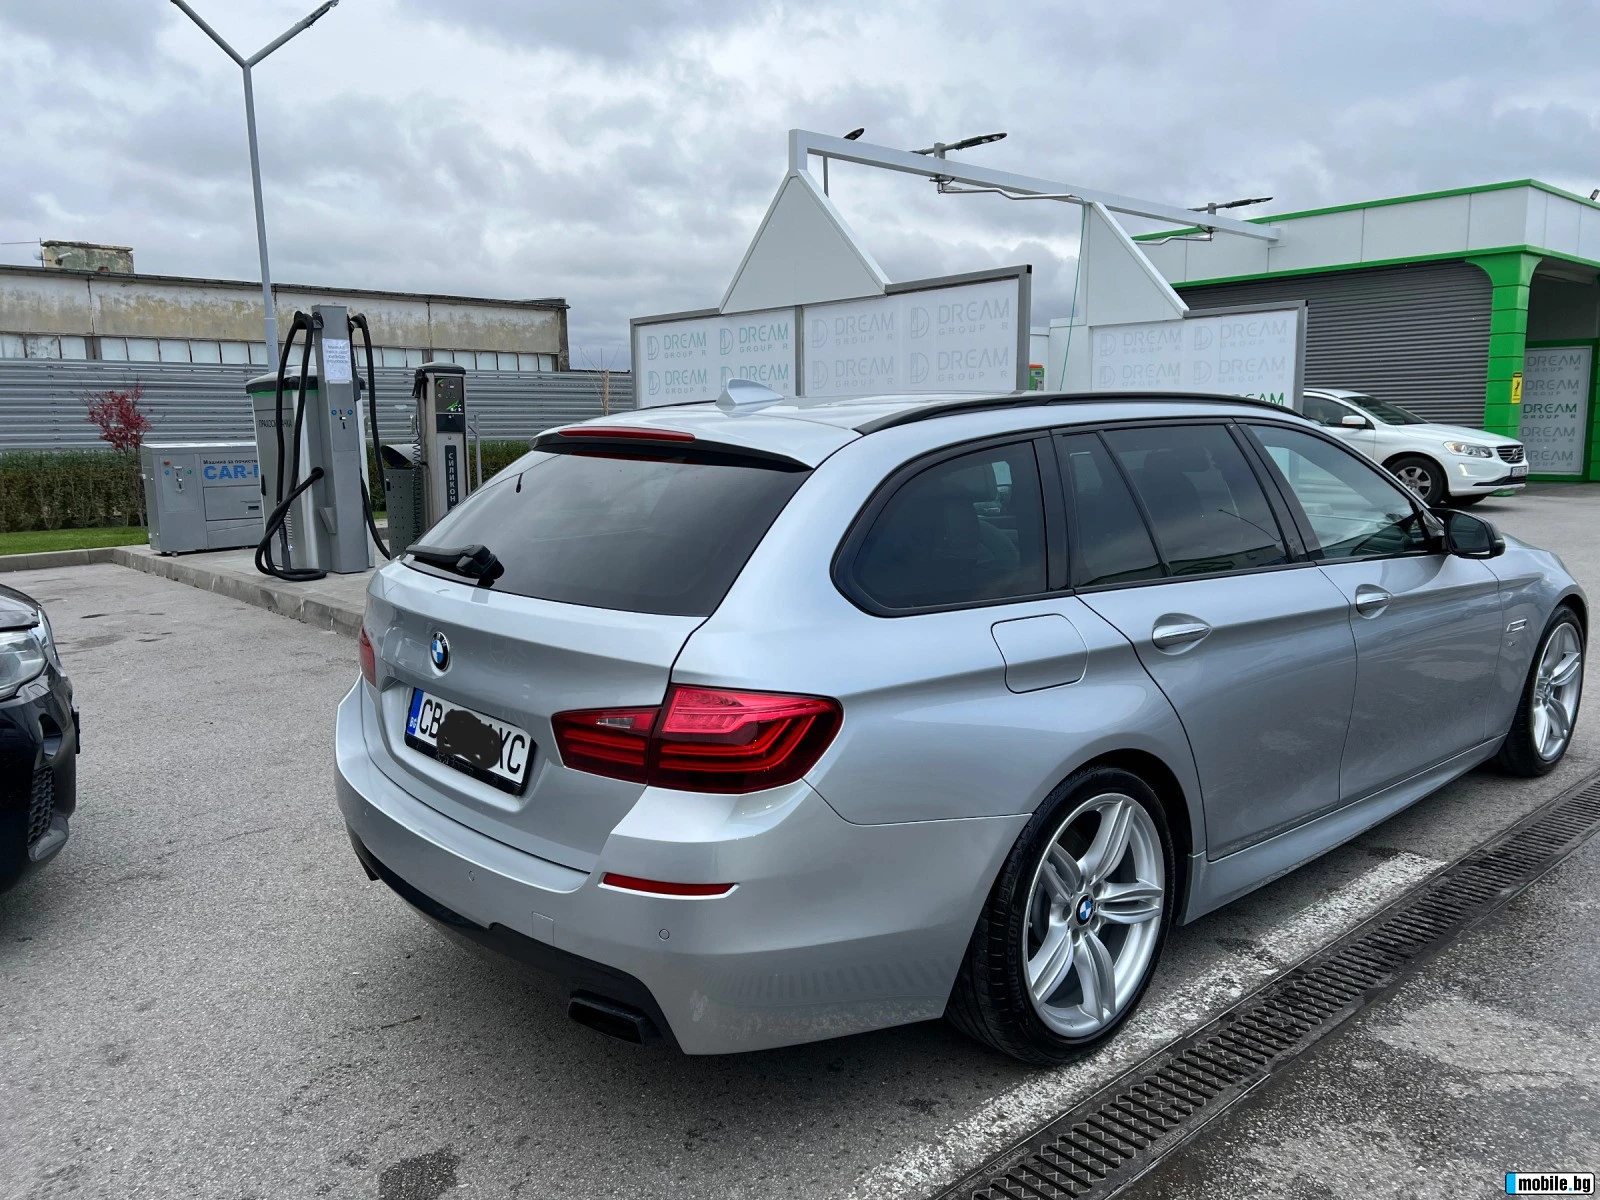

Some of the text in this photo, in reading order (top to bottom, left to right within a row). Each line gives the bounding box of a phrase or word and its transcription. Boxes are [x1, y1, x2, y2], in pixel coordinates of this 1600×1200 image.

[938, 297, 1010, 325] DREAM
[835, 311, 894, 336] DREAM
[1220, 320, 1287, 340] DREAM
[663, 331, 707, 350] DREAM
[739, 323, 789, 344] DREAM
[1123, 328, 1182, 347] DREAM
[835, 355, 894, 378] DREAM
[938, 347, 1009, 371] DREAM
[1219, 356, 1286, 375] DREAM
[1527, 354, 1581, 367] DREAM
[664, 368, 707, 386] DREAM
[1122, 361, 1181, 380] DREAM
[1525, 379, 1580, 390] DREAM
[1523, 403, 1577, 414] DREAM
[1521, 426, 1576, 437] DREAM
[447, 452, 456, 502] СИЛИКОН
